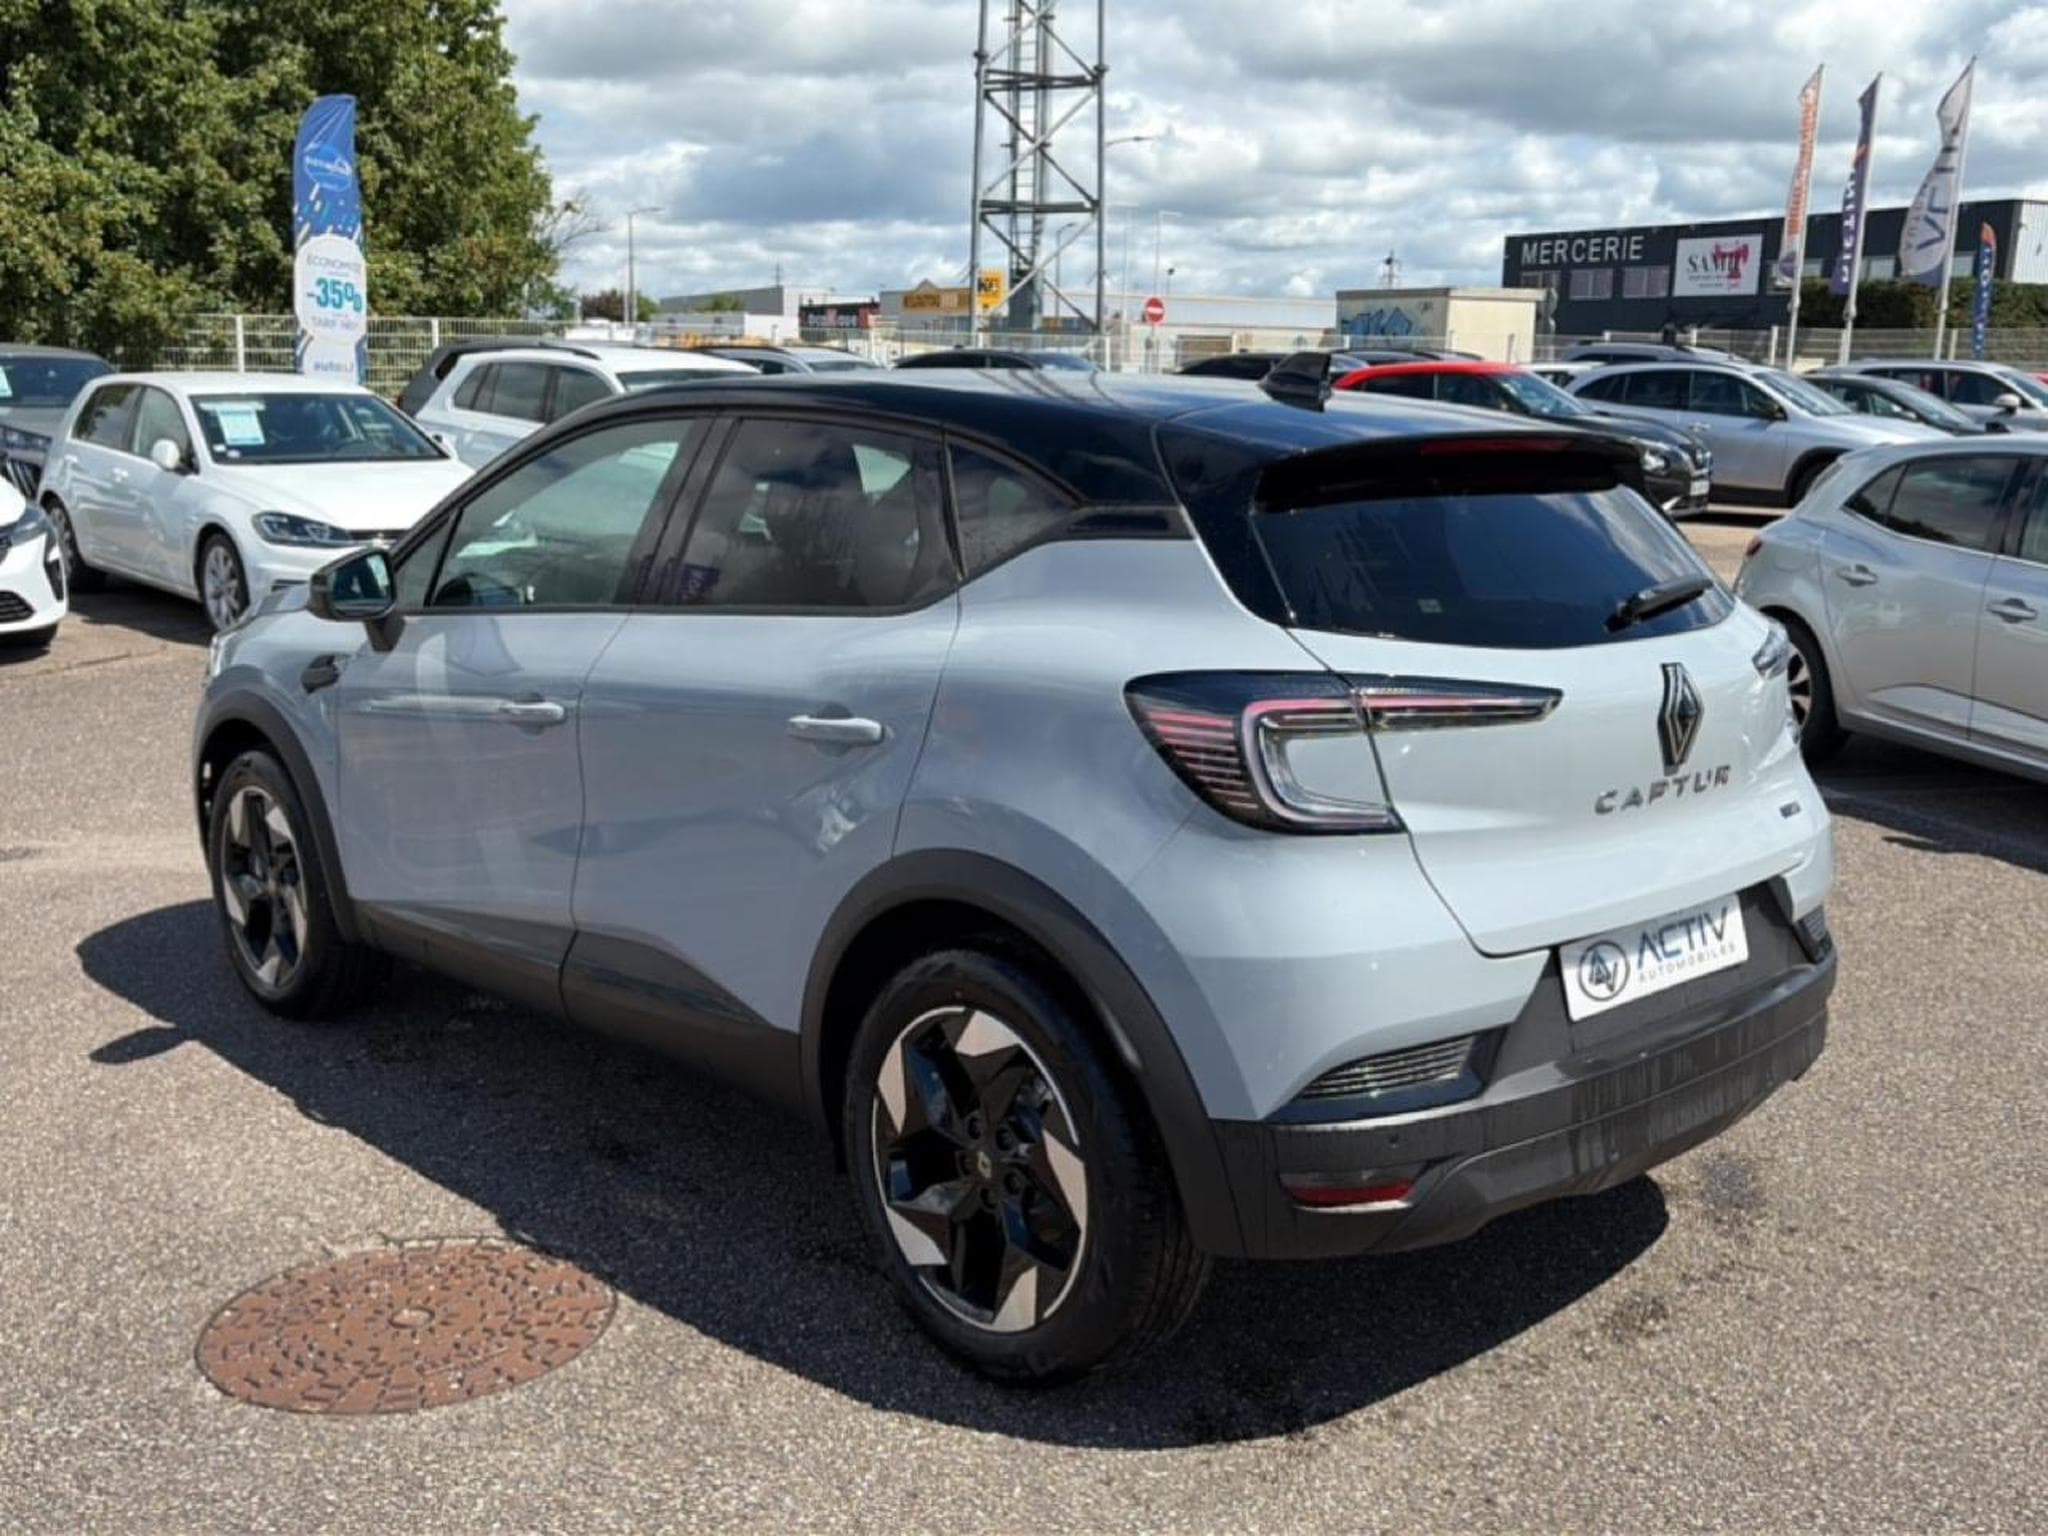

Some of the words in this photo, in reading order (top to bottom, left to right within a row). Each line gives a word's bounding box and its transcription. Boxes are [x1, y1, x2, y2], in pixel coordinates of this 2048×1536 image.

[1521, 235, 1644, 266] MERCERIE
[306, 278, 362, 313] -35%
[1594, 764, 1731, 815] CAPTUR
[1637, 905, 1728, 970] ACTIV
[1639, 942, 1736, 982] AUTOMOBILES
